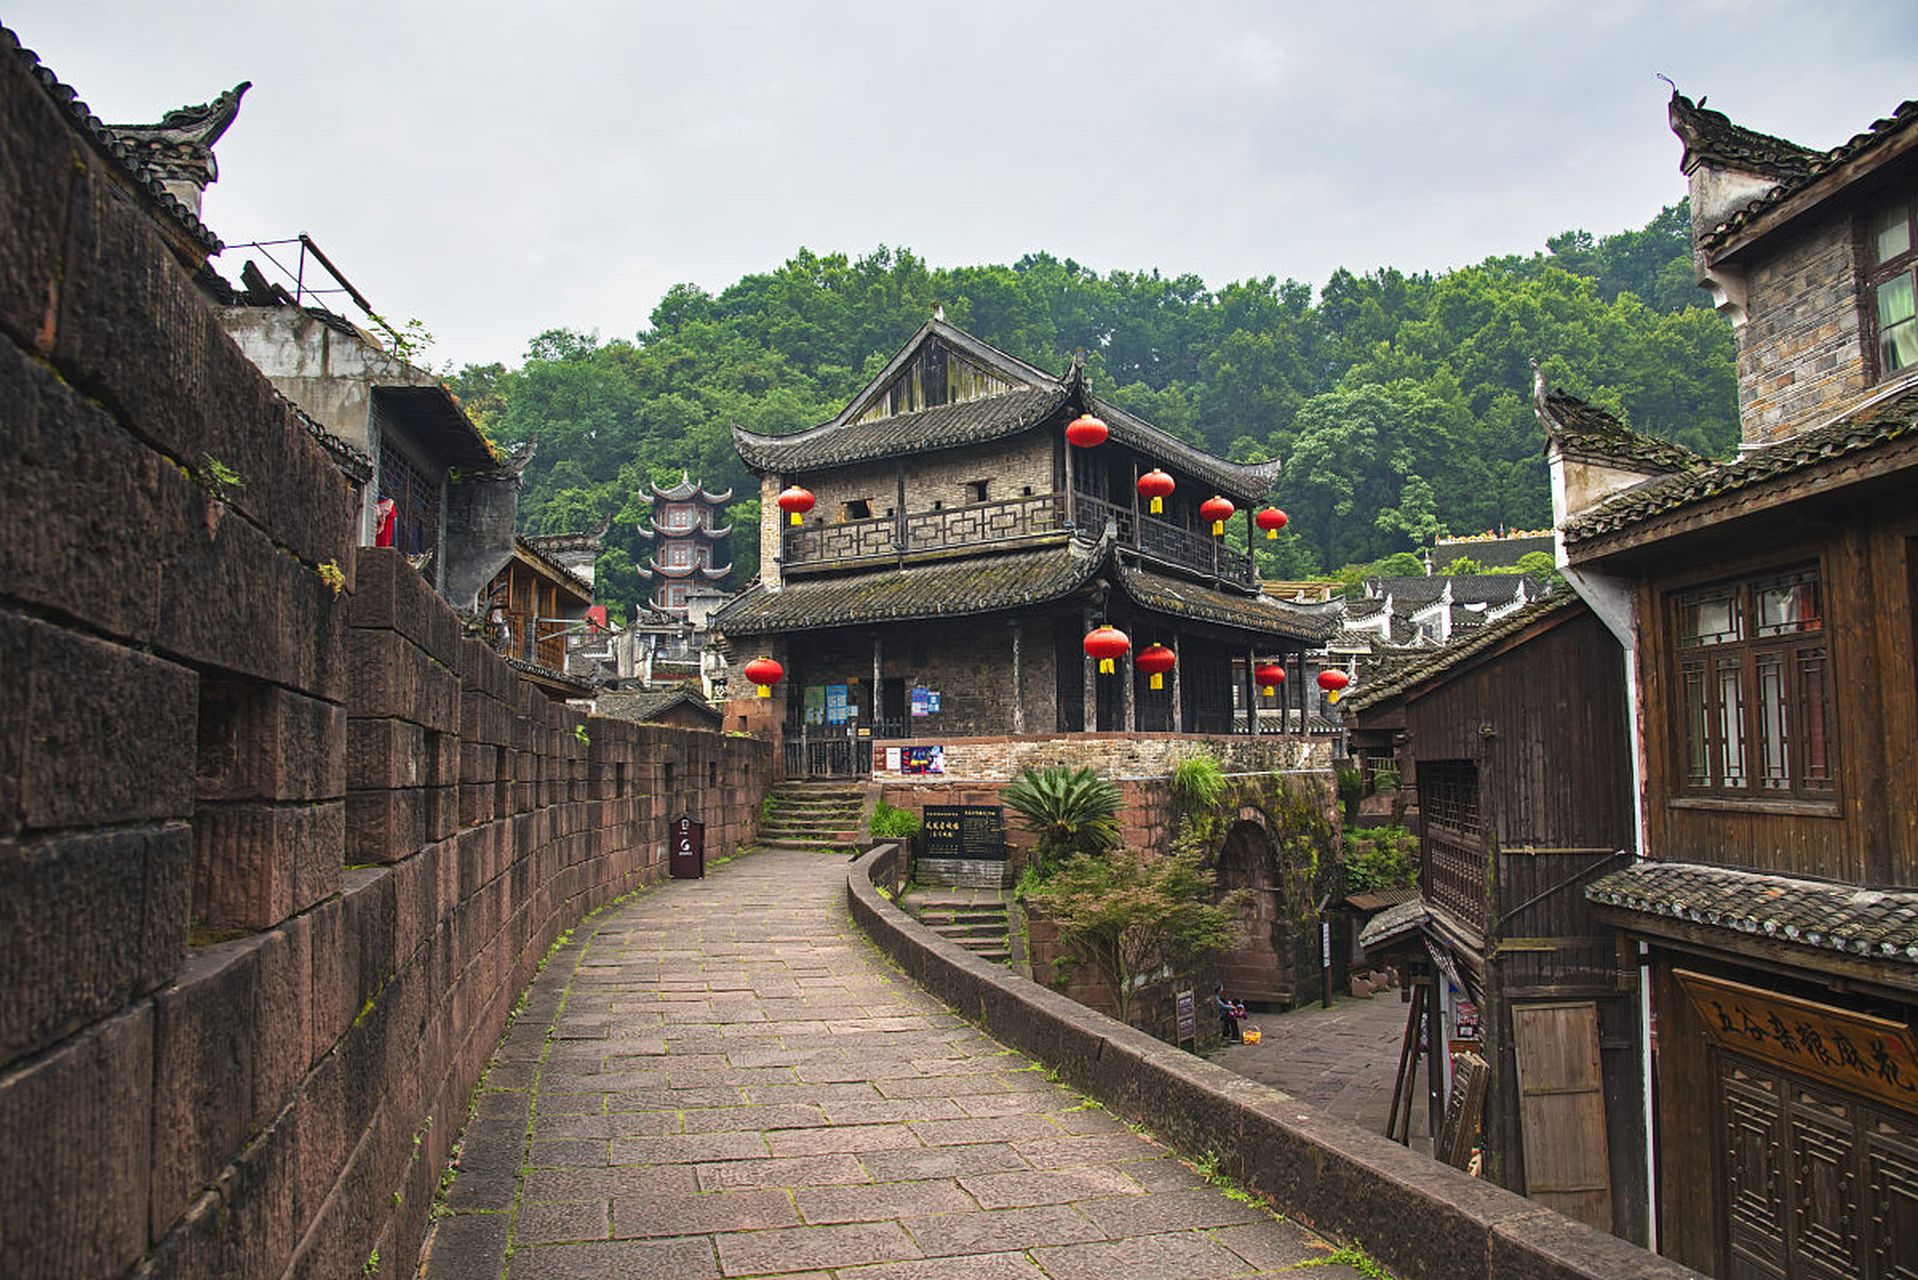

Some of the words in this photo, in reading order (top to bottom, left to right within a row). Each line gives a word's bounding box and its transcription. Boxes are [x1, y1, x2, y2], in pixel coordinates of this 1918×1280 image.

[1712, 1000, 1917, 1092] 五谷杂粮麻花
